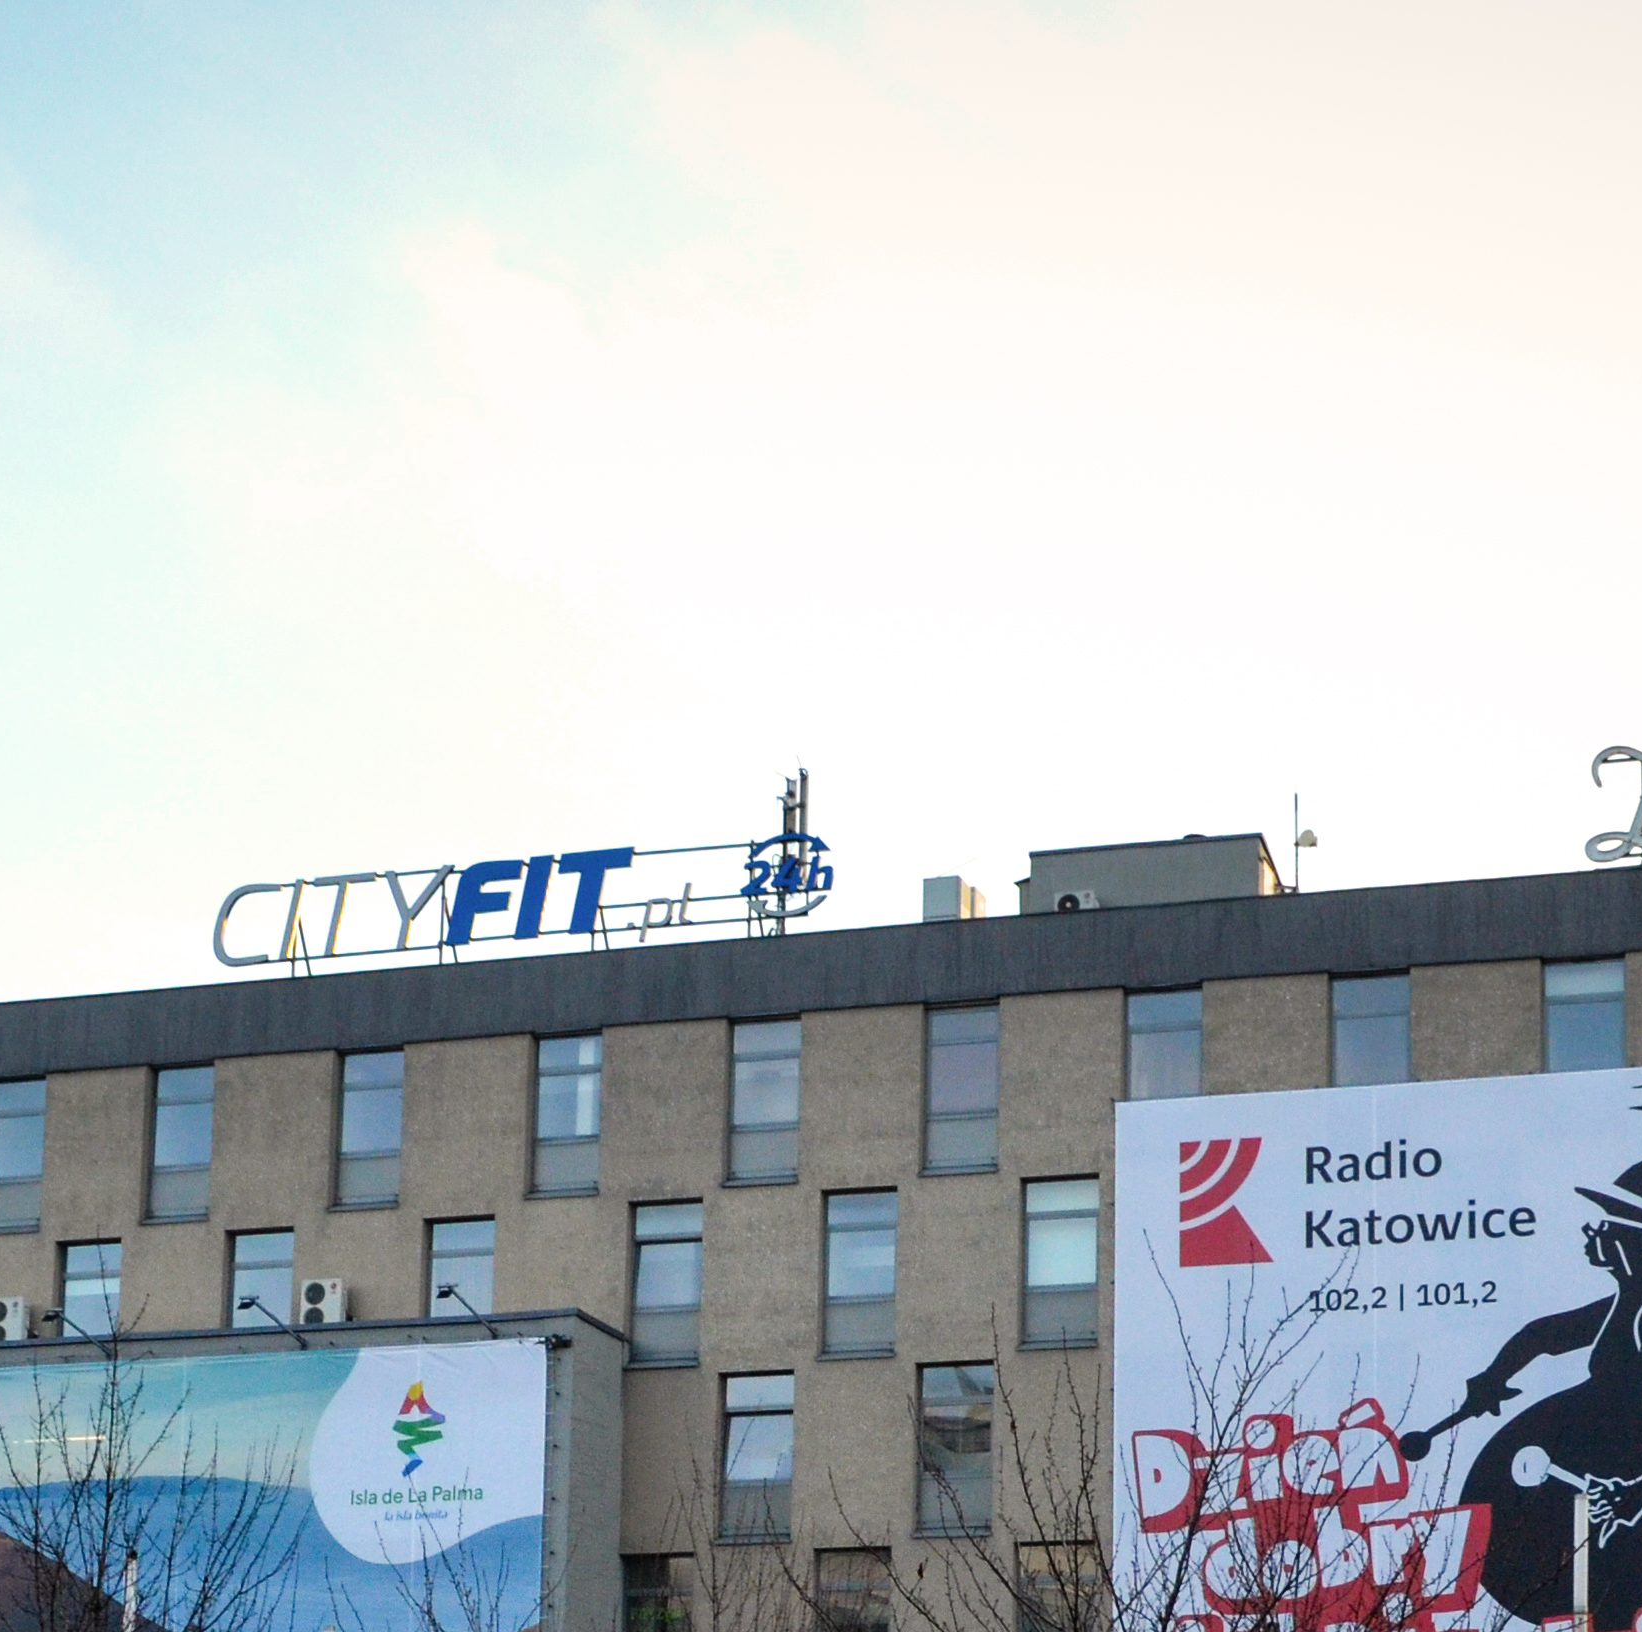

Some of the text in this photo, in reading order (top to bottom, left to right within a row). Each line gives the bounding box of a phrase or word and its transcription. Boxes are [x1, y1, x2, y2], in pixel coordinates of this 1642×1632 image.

[741, 853, 835, 898] 24h
[1305, 1141, 1443, 1184] Radio
[1304, 1199, 1538, 1249] Katowice
[1309, 1280, 1498, 1314] 102,2 101,2
[350, 1485, 484, 1506] Isla de La Palma
